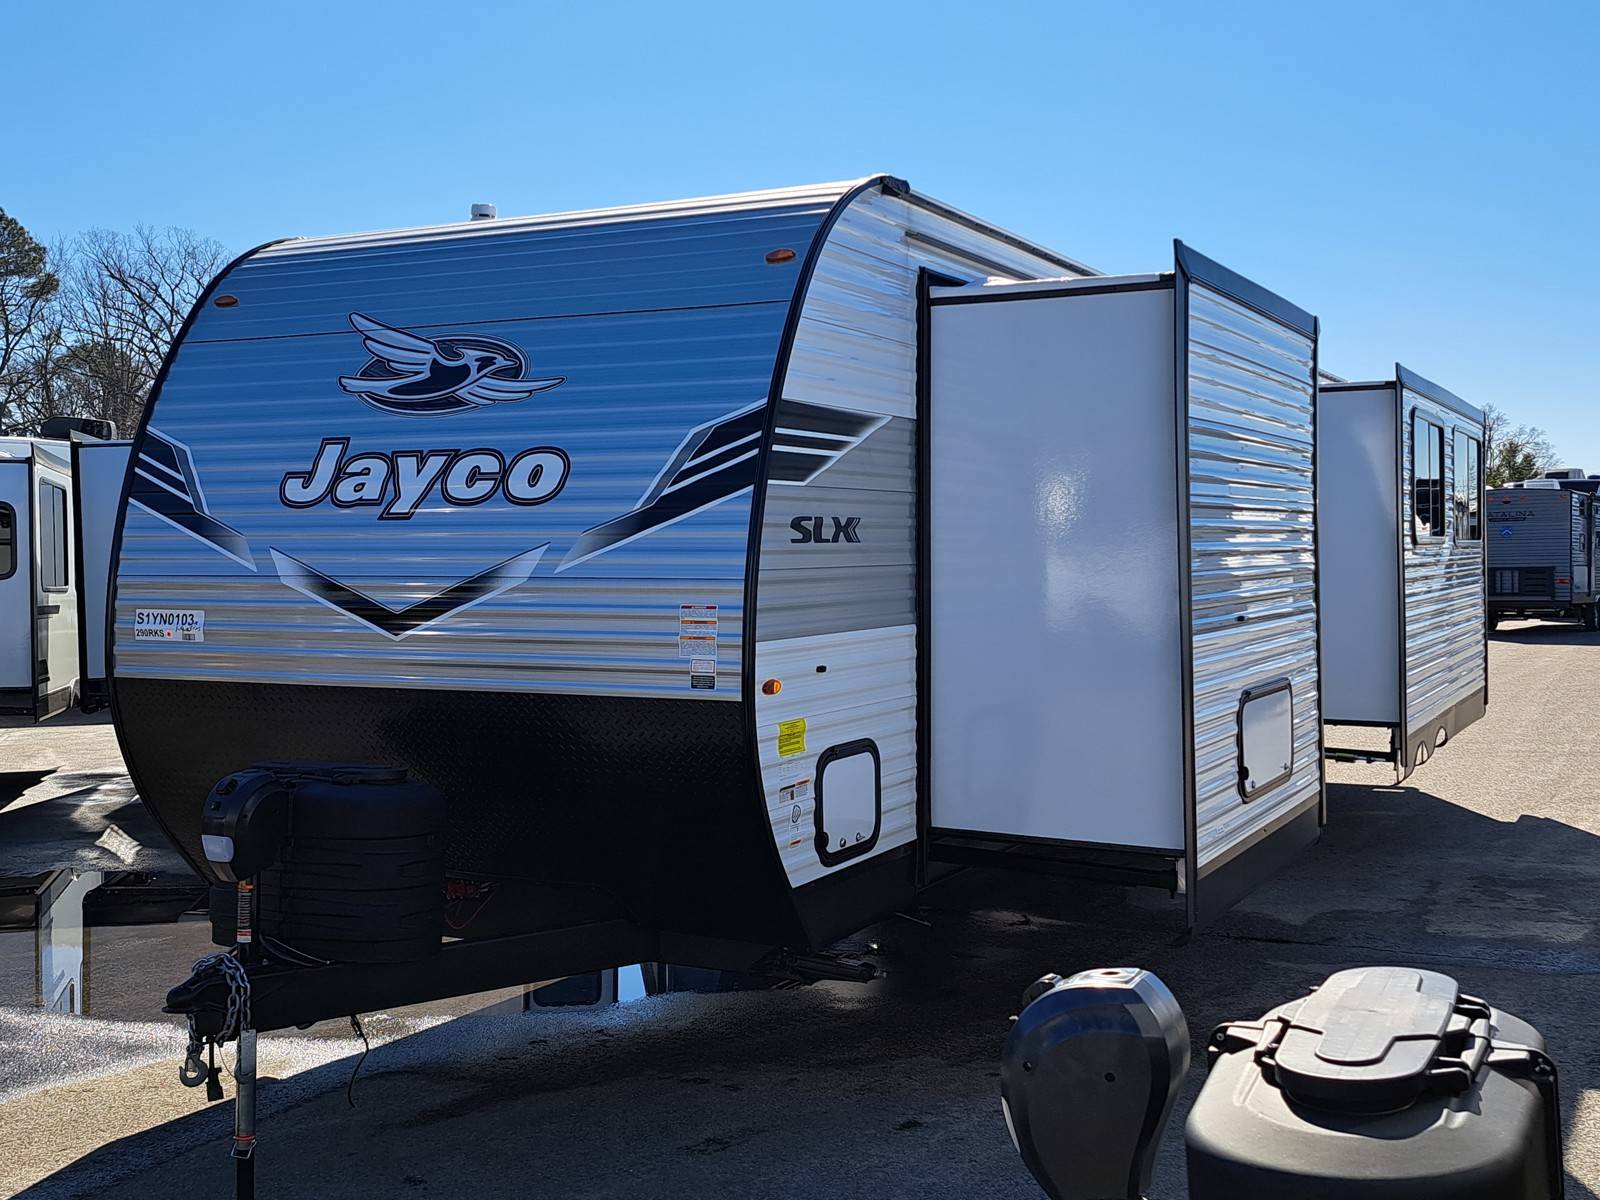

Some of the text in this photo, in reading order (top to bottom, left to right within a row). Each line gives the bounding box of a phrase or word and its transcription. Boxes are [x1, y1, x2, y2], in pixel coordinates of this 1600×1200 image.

[279, 437, 571, 521] Jayco
[1487, 510, 1536, 518] ATALINA
[790, 516, 861, 544] SLX
[137, 612, 195, 626] S1YN0103
[135, 628, 165, 638] 290RKS
